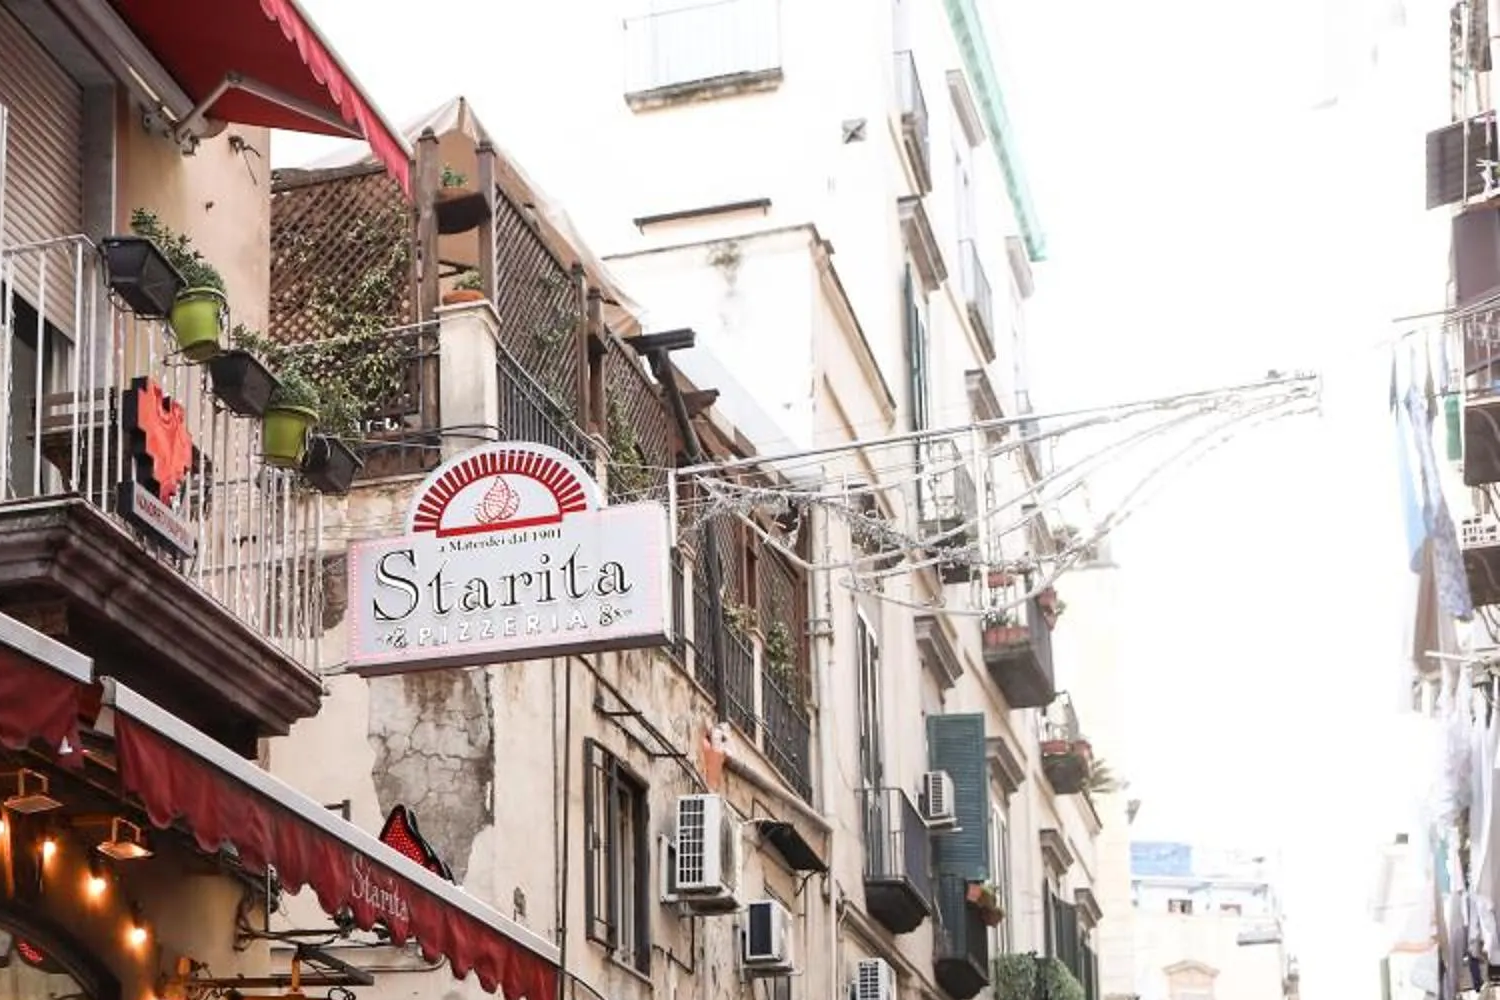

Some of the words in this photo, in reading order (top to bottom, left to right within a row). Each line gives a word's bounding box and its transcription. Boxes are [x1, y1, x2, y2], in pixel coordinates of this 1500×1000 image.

[449, 536, 505, 552] Materdei
[509, 531, 528, 545] dal
[532, 528, 562, 542] 1901
[373, 543, 632, 621] Starita
[419, 610, 587, 647] PIZZERIA
[351, 851, 409, 921] Starita
